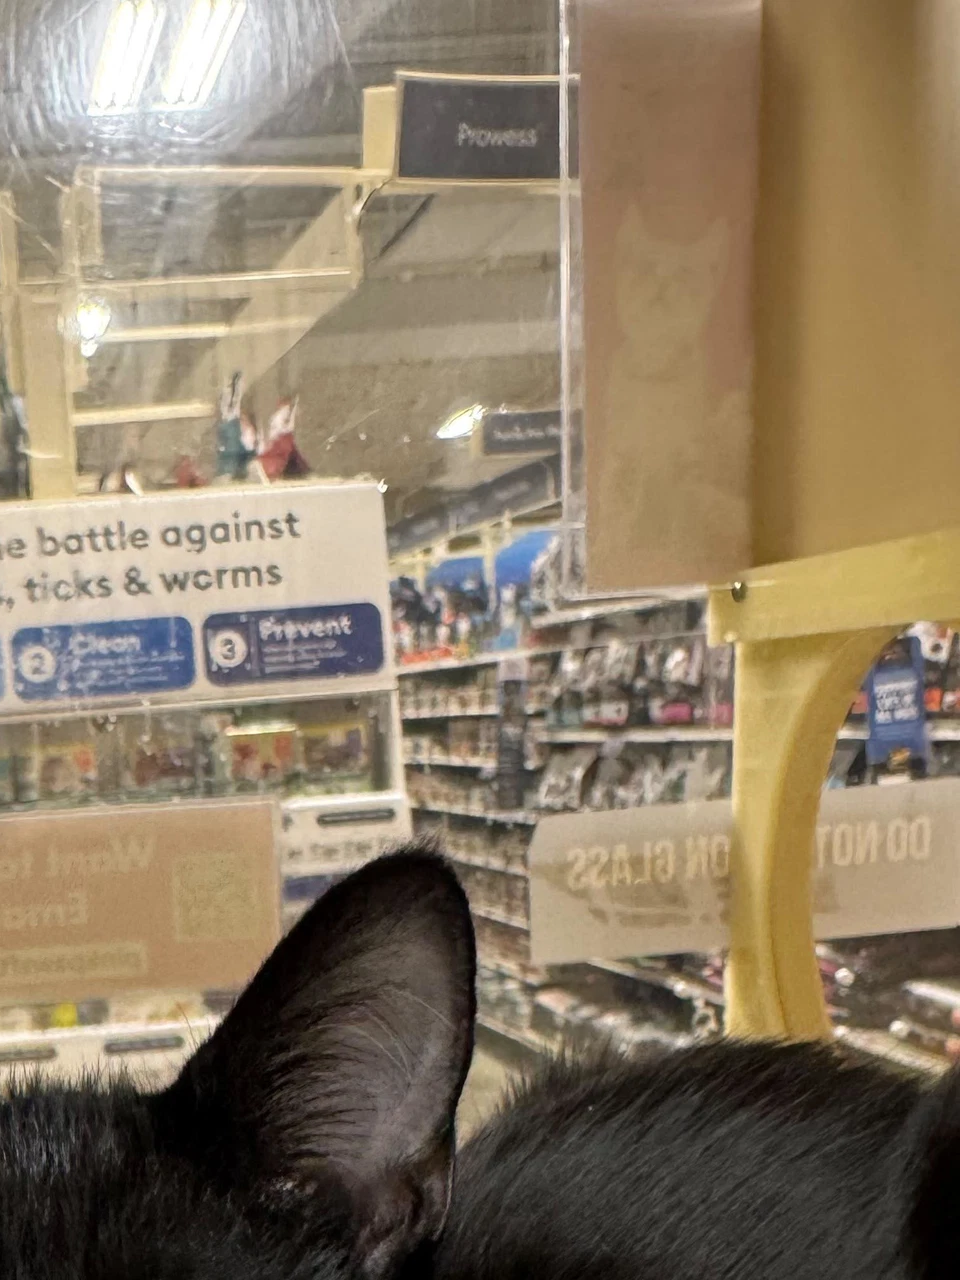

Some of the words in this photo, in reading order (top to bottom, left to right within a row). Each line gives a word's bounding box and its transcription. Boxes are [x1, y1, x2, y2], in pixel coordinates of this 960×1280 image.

[41, 522, 150, 556] battle
[162, 511, 301, 554] against
[24, 571, 112, 603] ticks
[125, 568, 150, 595] &
[160, 563, 283, 594] worms
